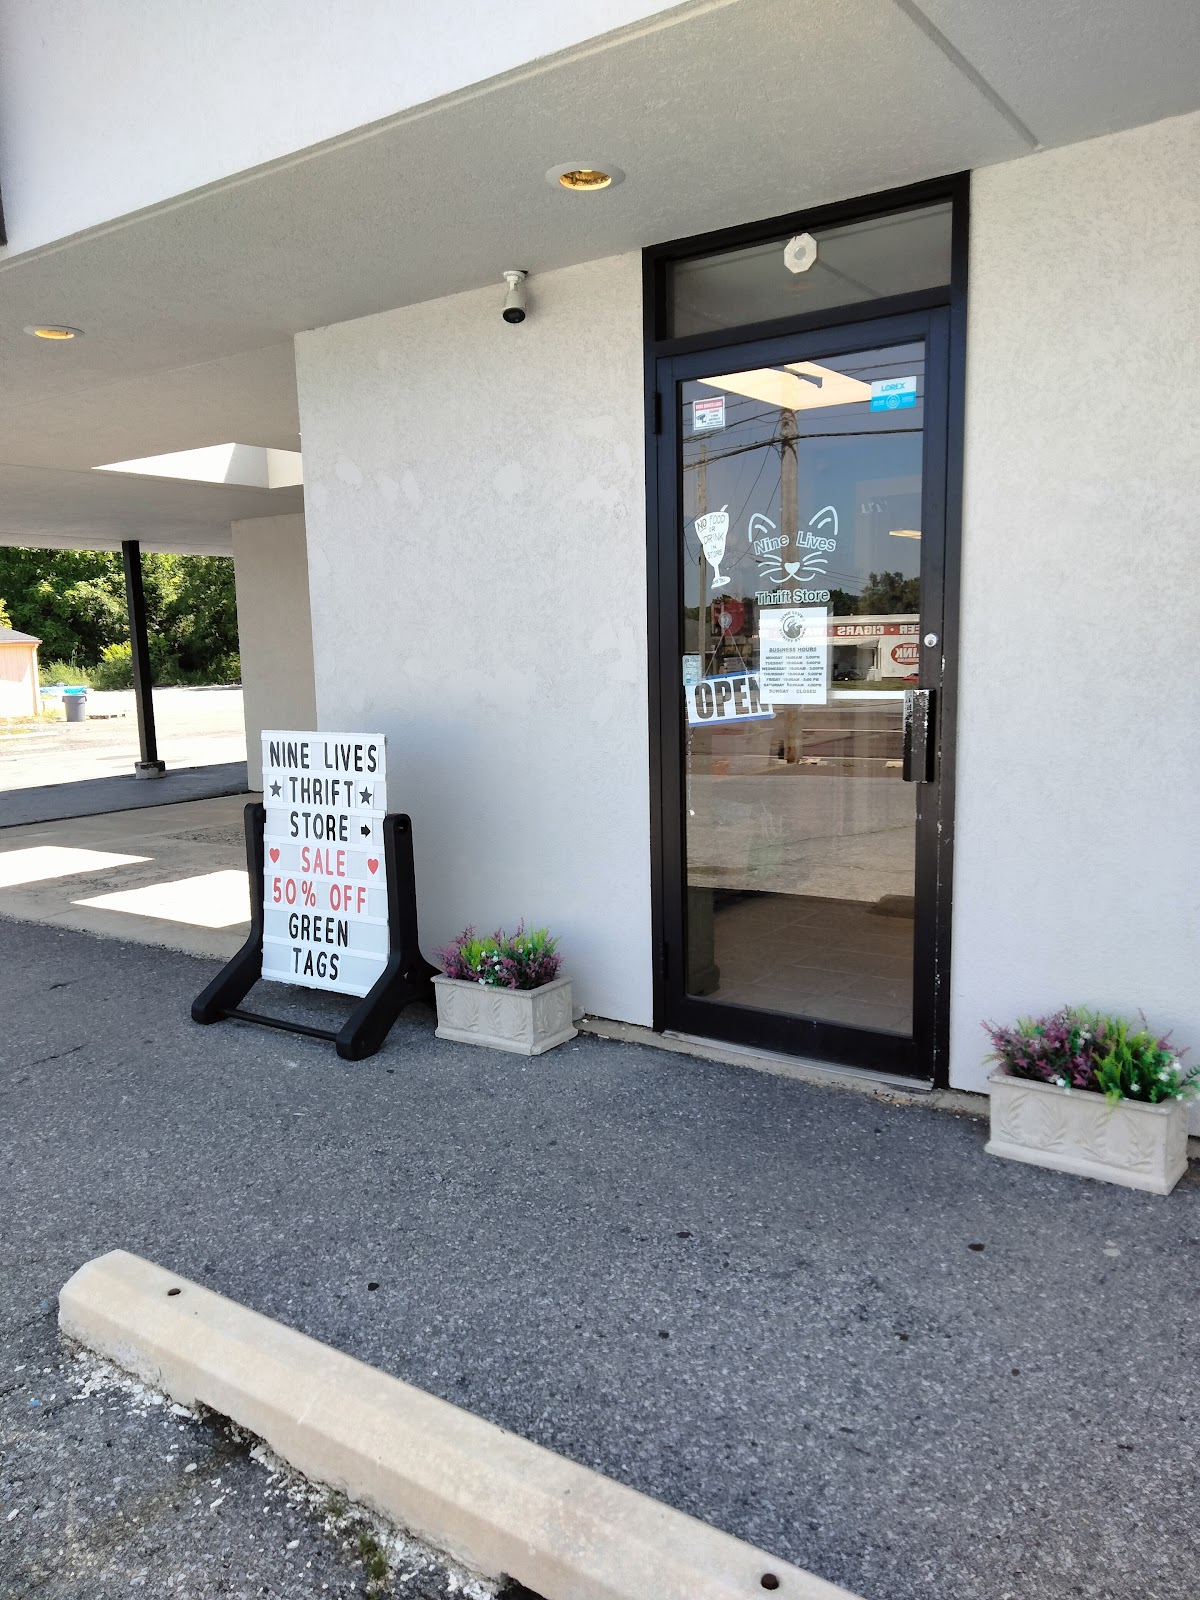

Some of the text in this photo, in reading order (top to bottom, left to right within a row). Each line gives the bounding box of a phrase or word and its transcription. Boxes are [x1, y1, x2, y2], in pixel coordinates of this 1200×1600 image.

[881, 383, 905, 392] LOREX
[696, 514, 726, 532] NO FOOD
[702, 532, 724, 545] DRINK
[707, 549, 723, 559] STORE
[754, 530, 836, 555] Nine Lives
[755, 588, 830, 606] Thrift Store
[694, 676, 770, 719] OPEN
[269, 741, 377, 773] NINE LIVES
[288, 776, 354, 808] THRIFT
[290, 810, 348, 842] STORE
[301, 846, 346, 877] SALE
[273, 877, 366, 914] 50% OFF
[288, 912, 348, 948] GREEN
[292, 947, 340, 981] TAGS
